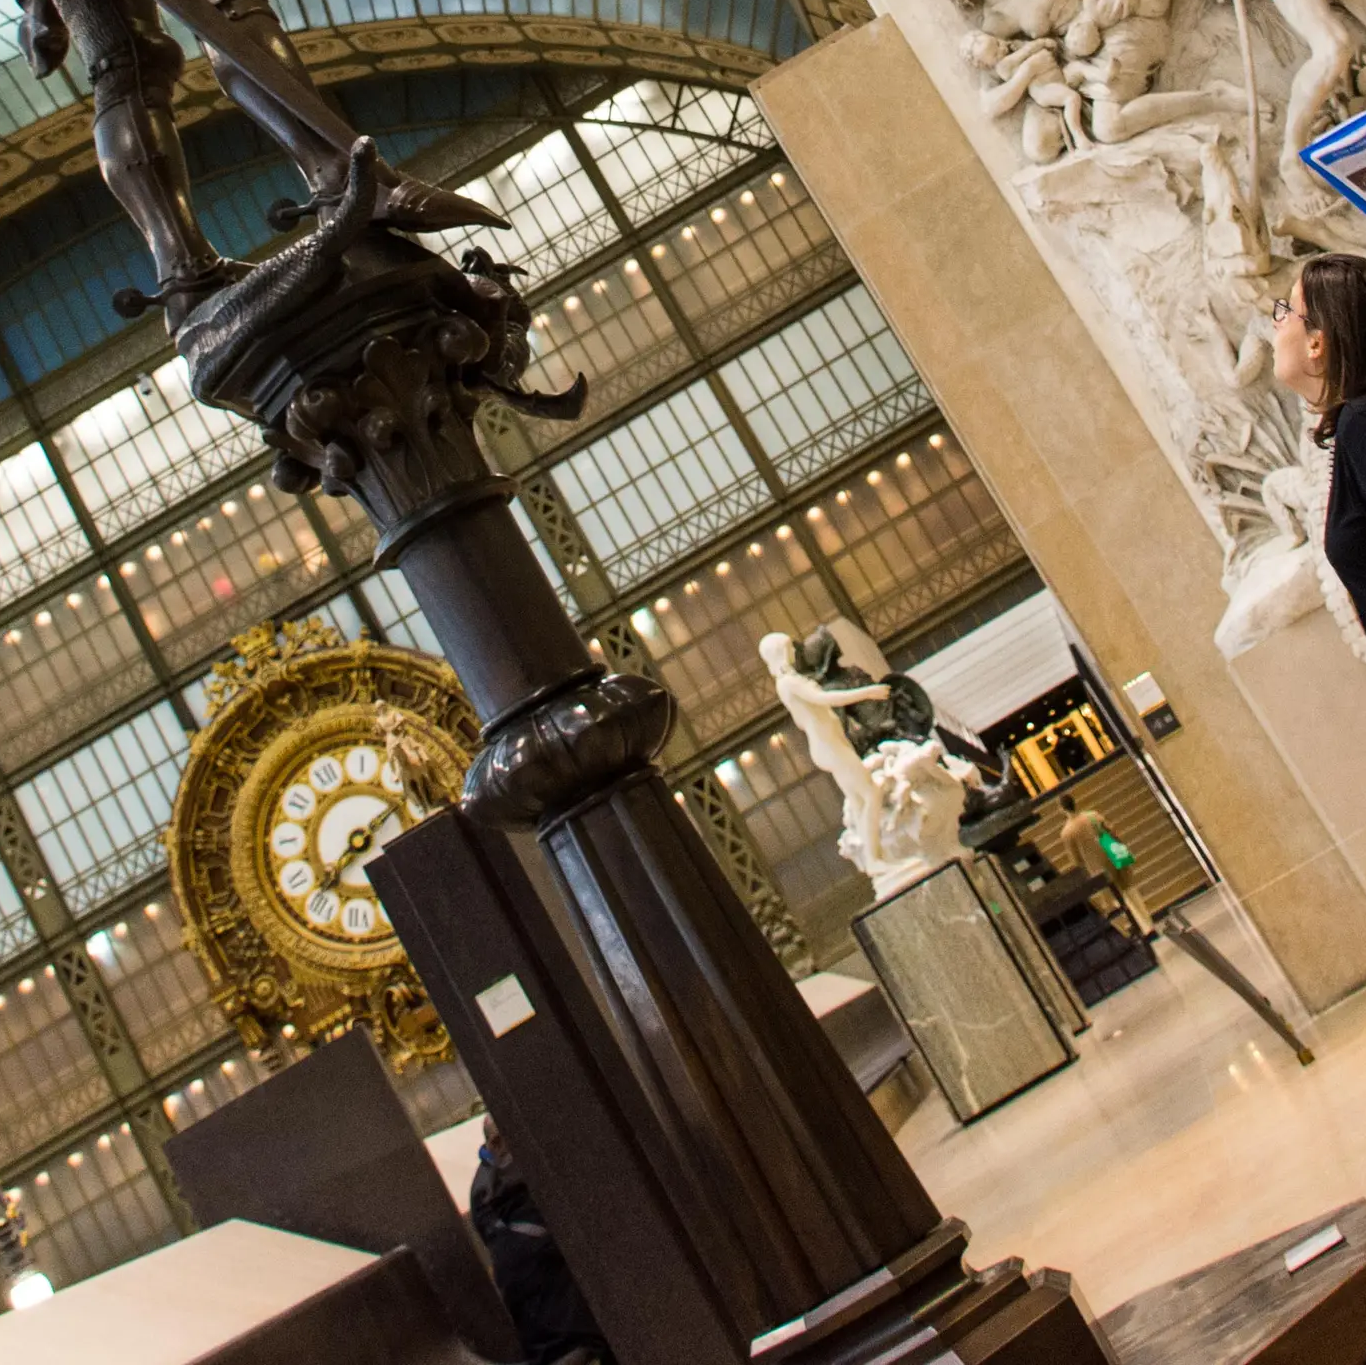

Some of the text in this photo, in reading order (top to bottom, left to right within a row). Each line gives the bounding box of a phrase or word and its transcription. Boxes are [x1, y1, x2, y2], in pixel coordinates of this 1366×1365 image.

[314, 761, 339, 786] XII
[359, 754, 366, 775] I
[288, 791, 311, 814] XI
[347, 906, 370, 929] VII
